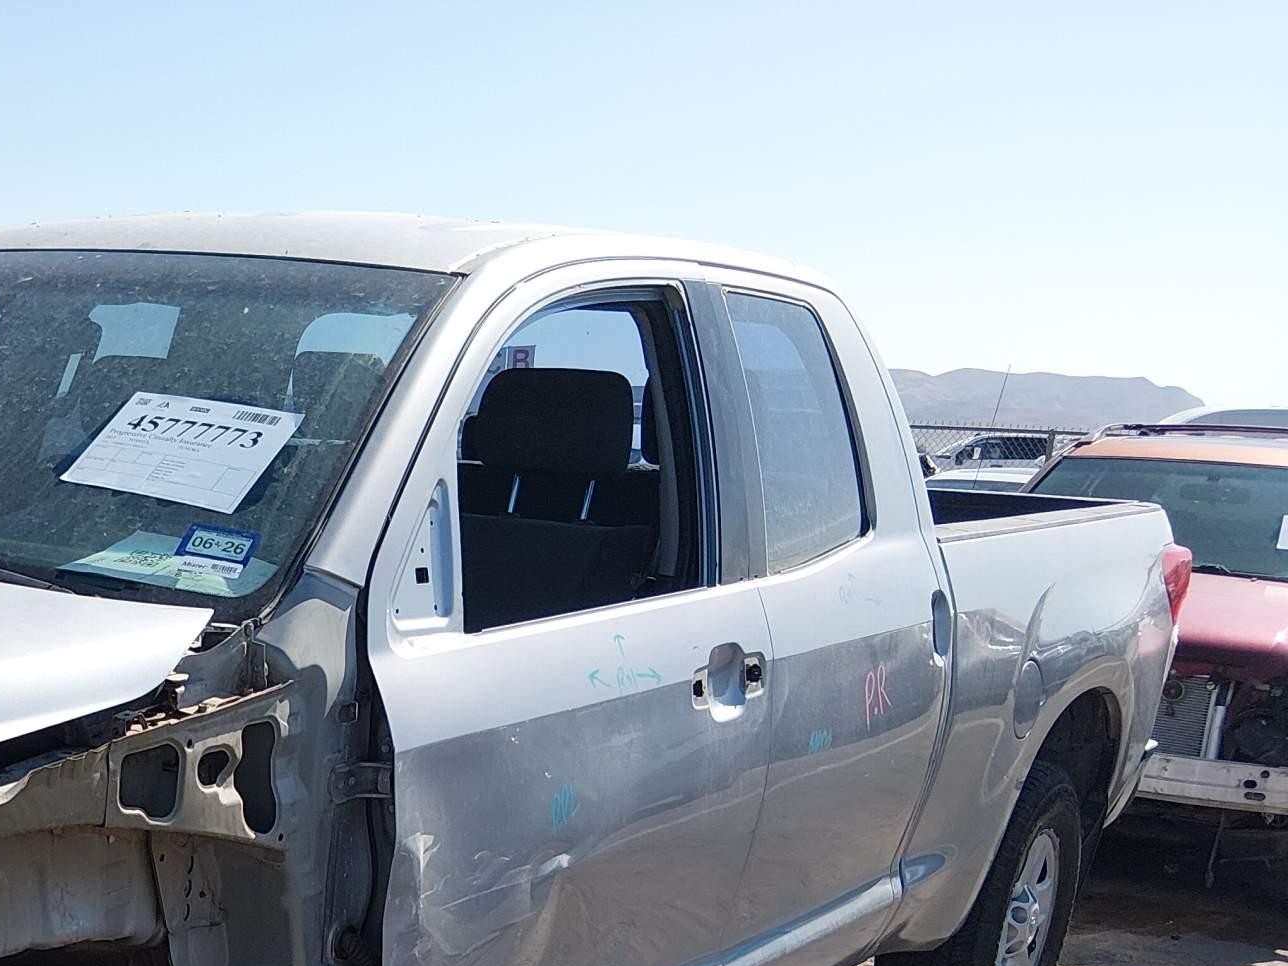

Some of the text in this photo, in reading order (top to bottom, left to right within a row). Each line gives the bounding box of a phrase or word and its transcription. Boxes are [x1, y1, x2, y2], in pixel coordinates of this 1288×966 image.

[126, 414, 263, 449] 45777773
[191, 536, 247, 555] 06 26
